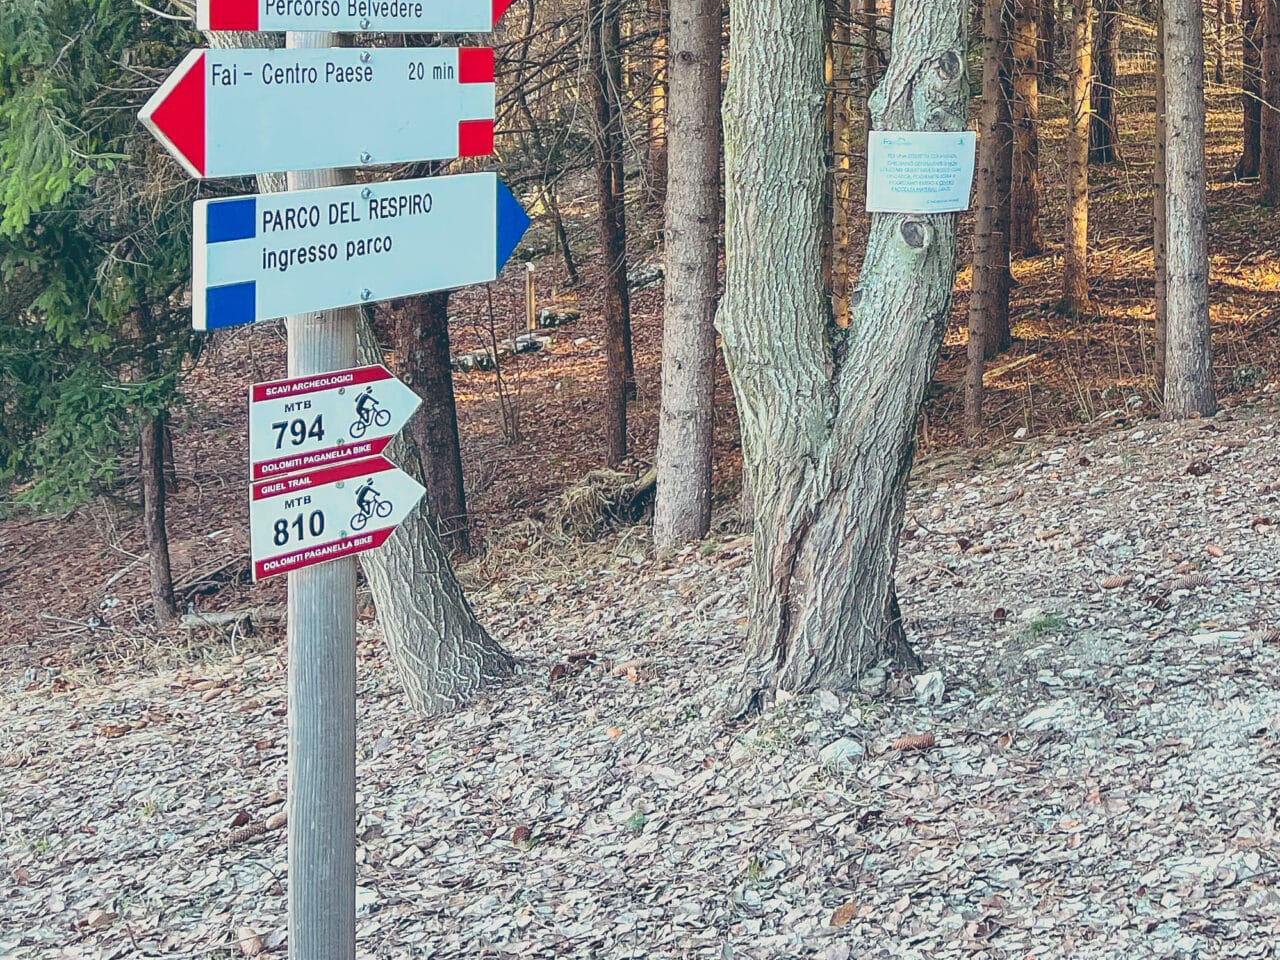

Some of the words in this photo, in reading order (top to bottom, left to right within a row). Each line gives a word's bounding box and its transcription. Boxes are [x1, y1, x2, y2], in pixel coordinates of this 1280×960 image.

[211, 63, 238, 86] Fai
[262, 63, 319, 84] Centro
[325, 62, 373, 83] Paese
[408, 62, 426, 81] 20
[432, 61, 455, 80] min
[262, 205, 320, 232] PARCO
[329, 202, 361, 228] DEL
[368, 193, 433, 220] RESPIRO
[262, 241, 338, 272] ingresso
[346, 235, 393, 261] parco
[265, 385, 291, 396] SCAVI
[291, 374, 353, 392] ARCHEOLOGICI
[284, 400, 312, 413] MTB
[271, 413, 325, 450] 794
[261, 458, 302, 473] DOLOMITI
[303, 447, 351, 465] PAGANELLA
[352, 443, 372, 454] BIKE
[261, 481, 287, 494] GIUEL
[287, 476, 312, 488] TRAIL
[284, 495, 312, 510] MTB
[272, 509, 325, 547] 810
[263, 554, 304, 571] DOLOMITI
[304, 543, 353, 561] PAGANELLA
[353, 535, 373, 547] BIKE
